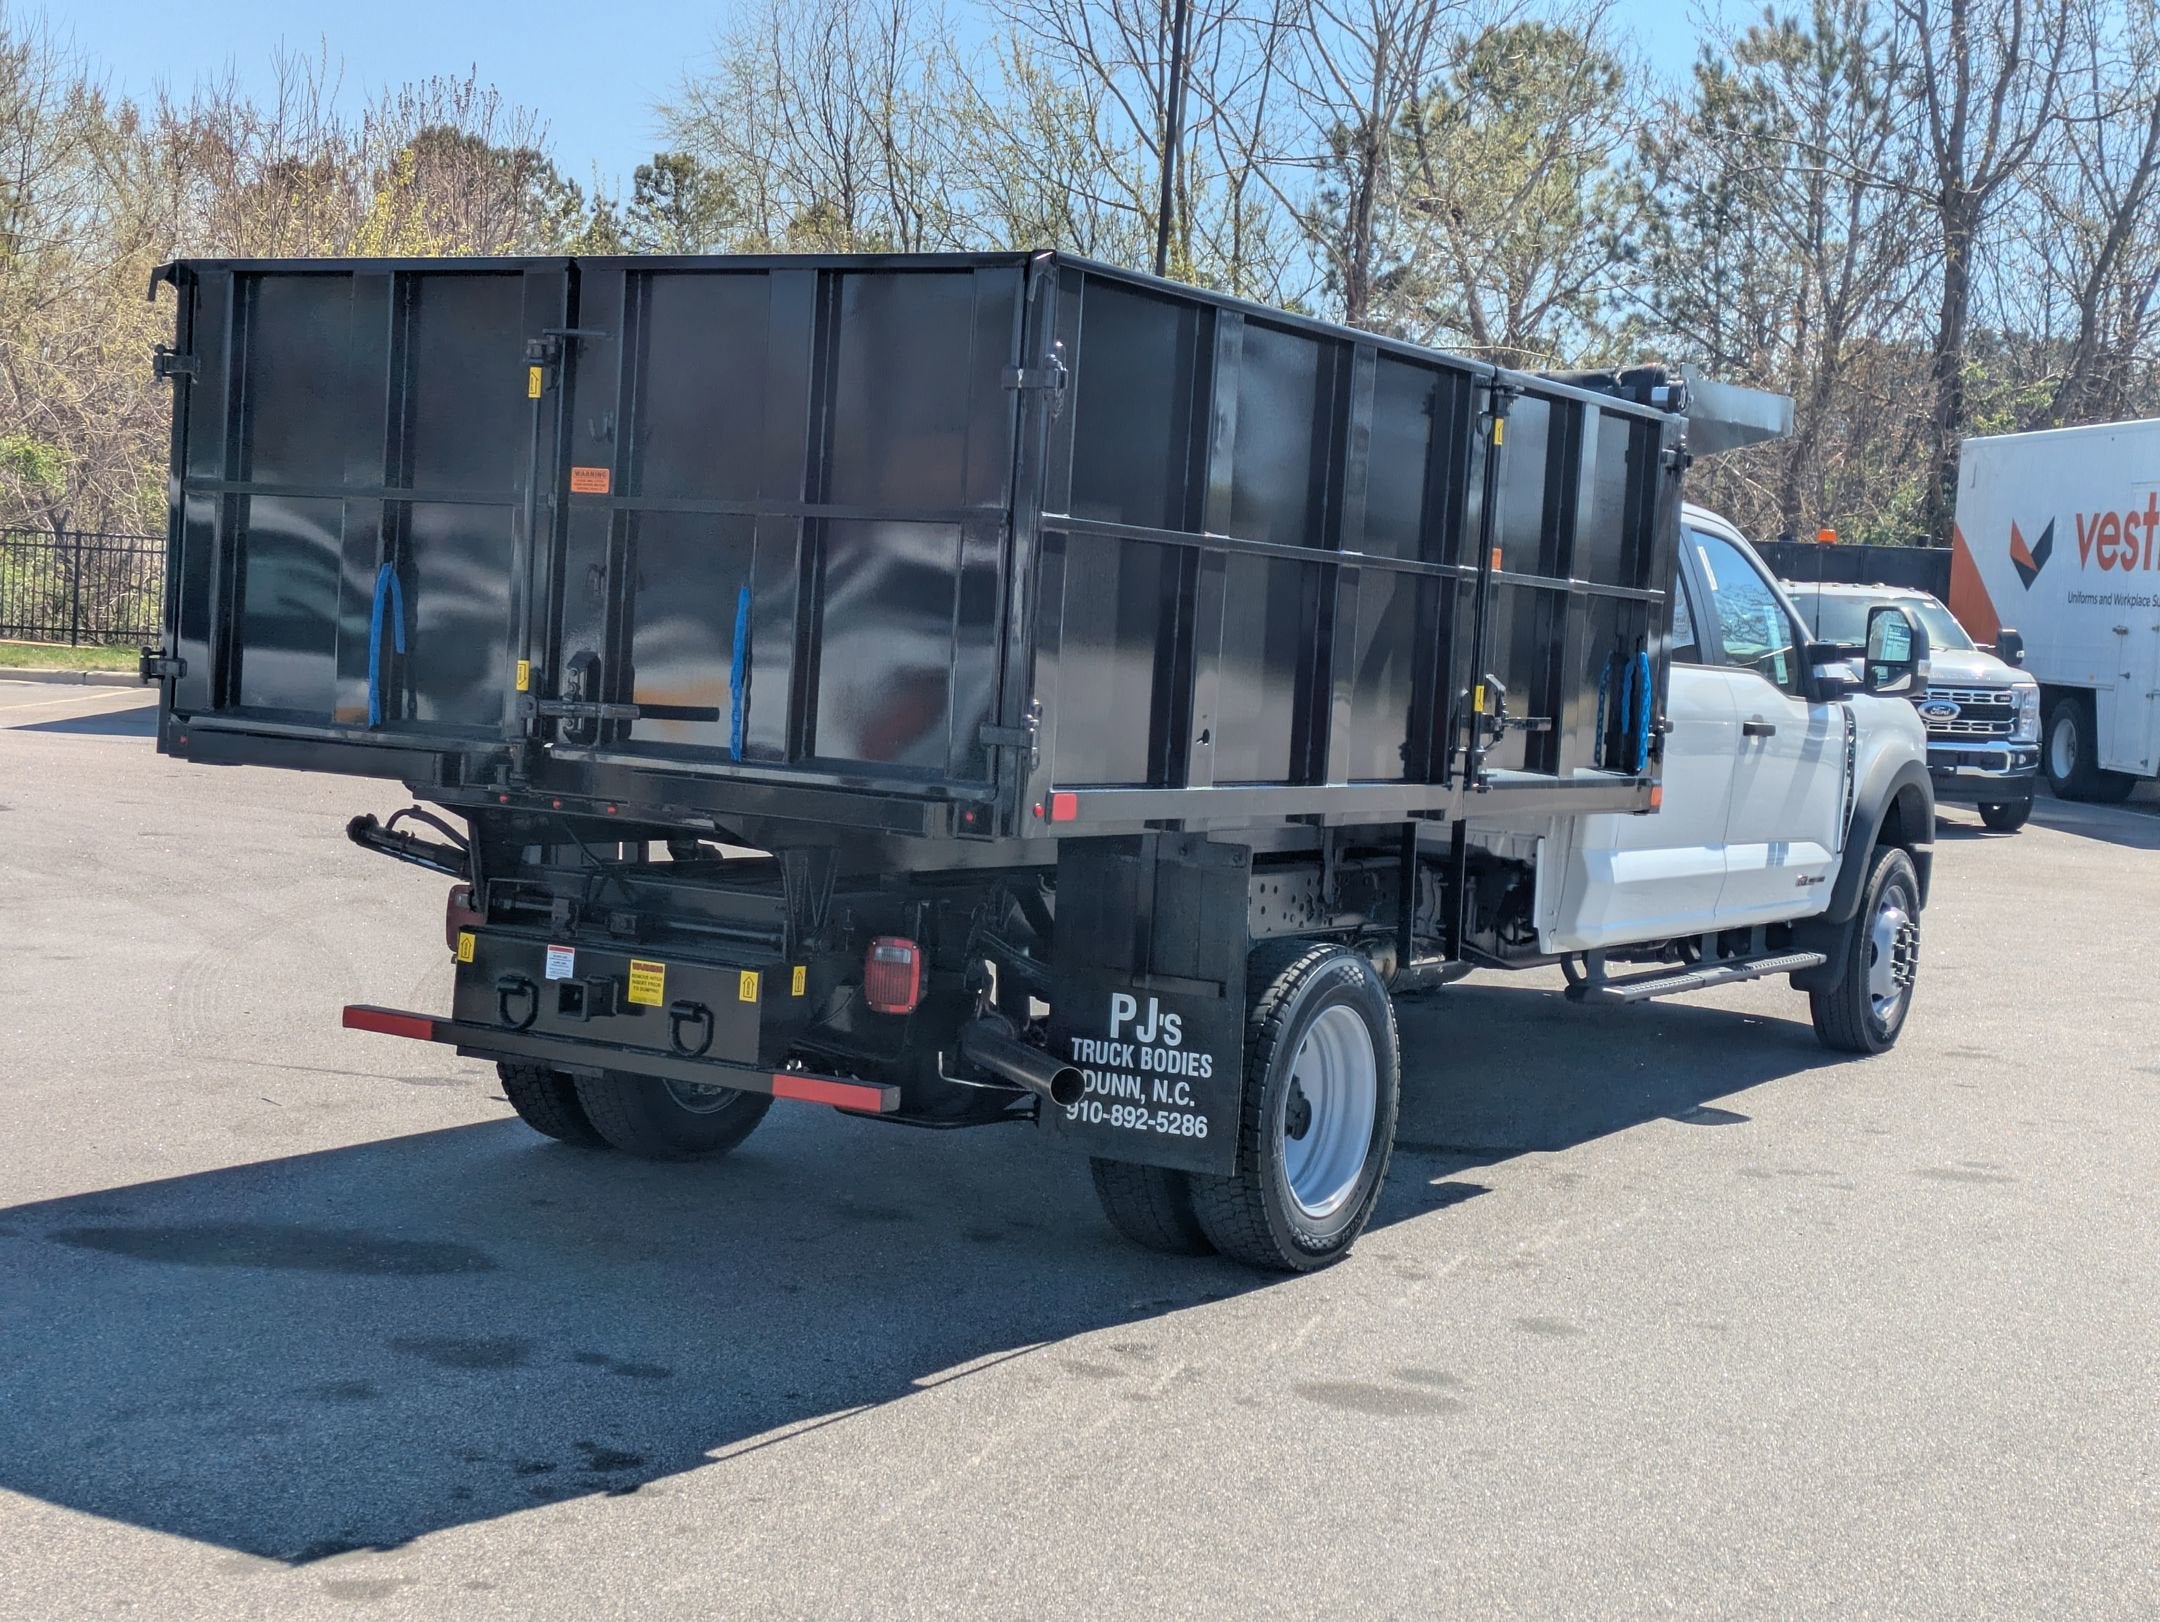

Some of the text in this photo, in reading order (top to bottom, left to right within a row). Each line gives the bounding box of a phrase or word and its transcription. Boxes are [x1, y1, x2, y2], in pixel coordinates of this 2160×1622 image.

[2075, 491, 2160, 573] vest
[2067, 591, 2098, 605] Uniforms
[2099, 592, 2112, 606] and
[2114, 593, 2151, 609] Workplace
[1929, 706, 1951, 717] Ford
[1071, 1037, 1213, 1078] TRUCK BODIES
[1083, 1069, 1195, 1107] DUNN, N.C.
[1066, 1100, 1208, 1138] 910-892-5286
